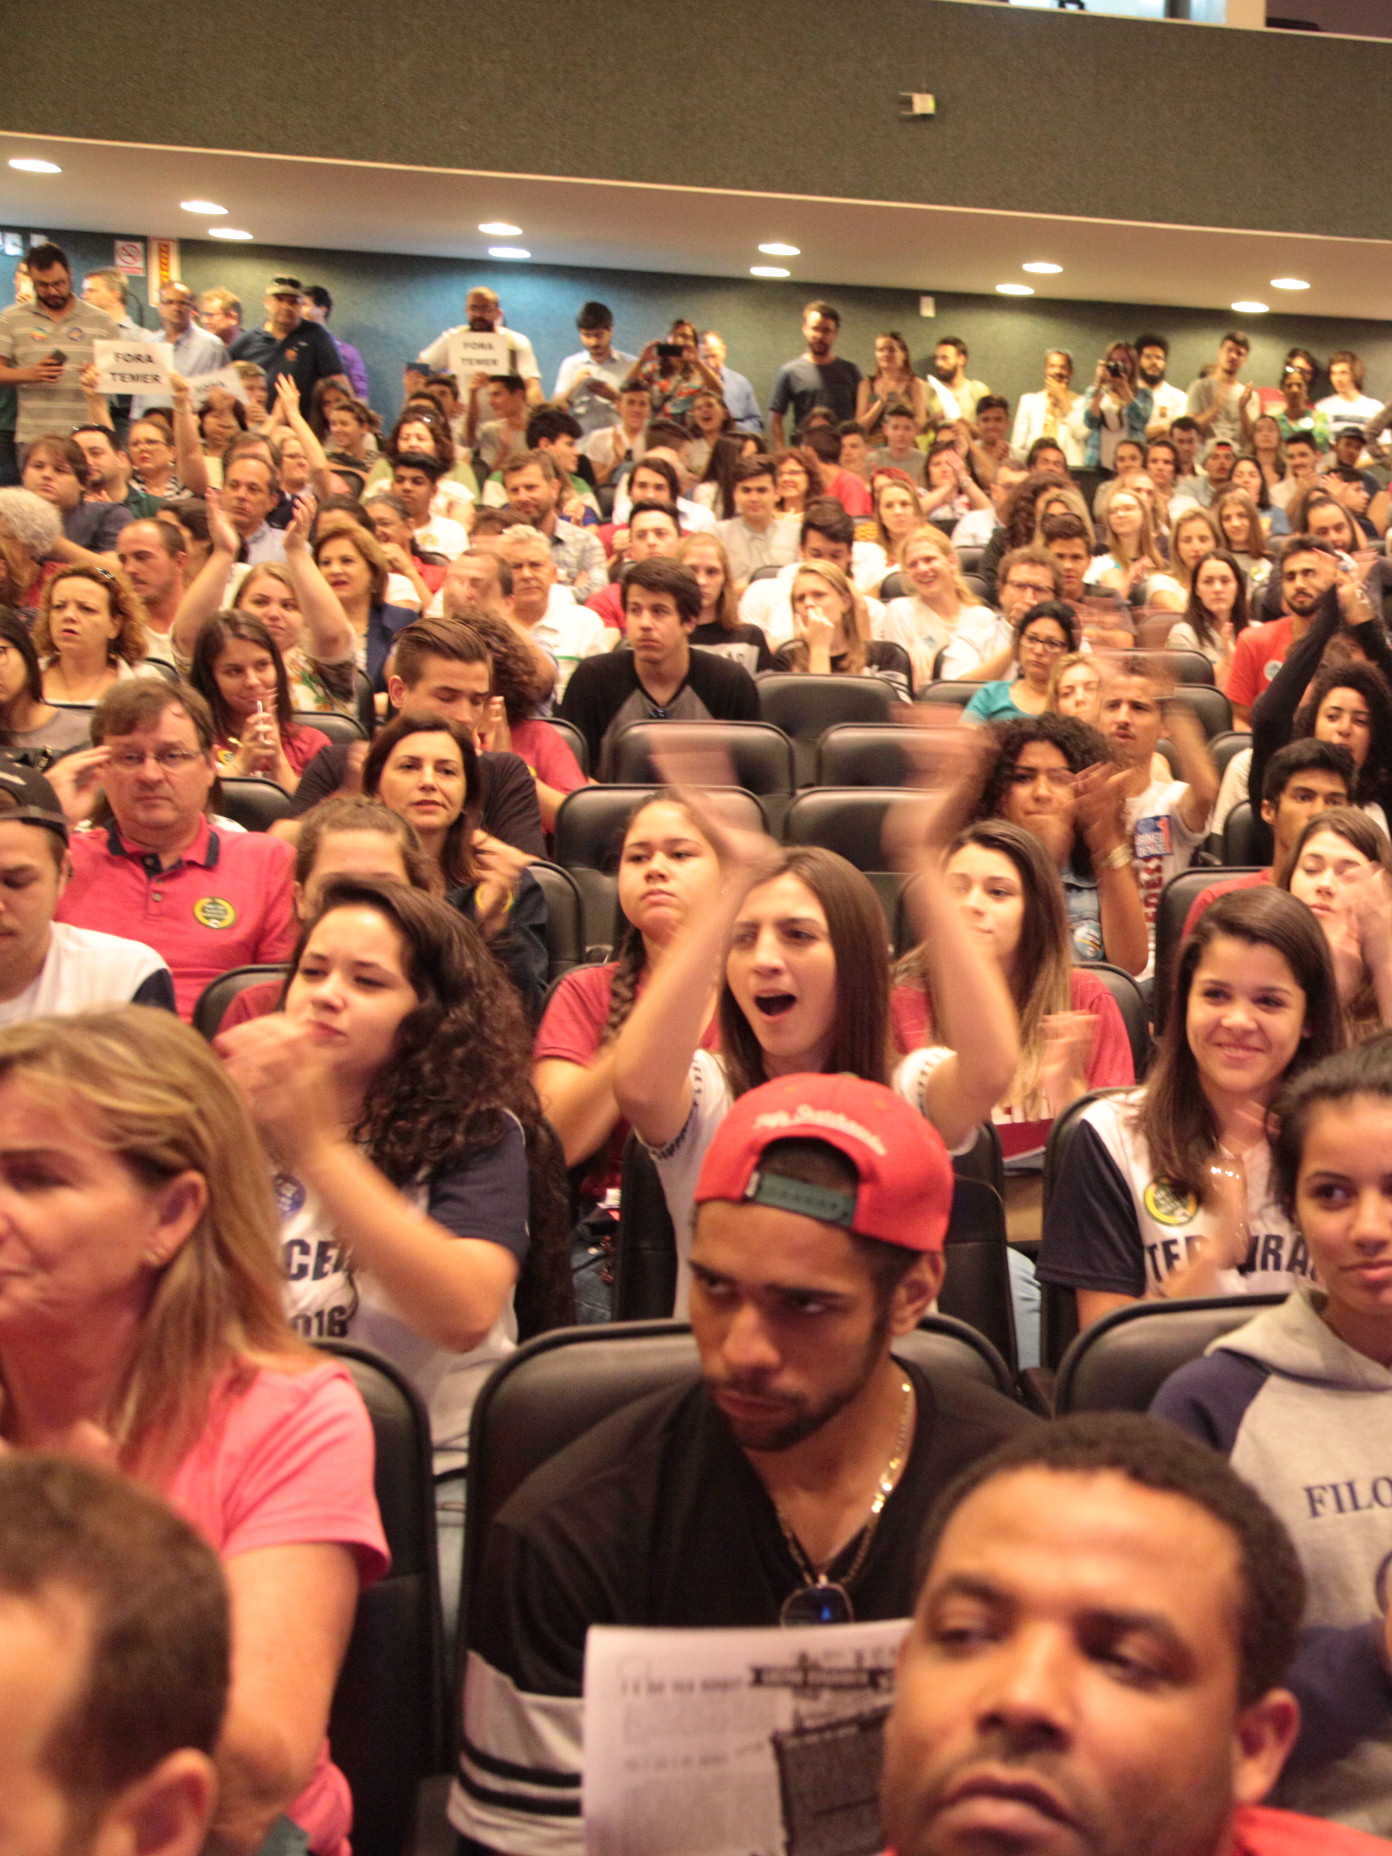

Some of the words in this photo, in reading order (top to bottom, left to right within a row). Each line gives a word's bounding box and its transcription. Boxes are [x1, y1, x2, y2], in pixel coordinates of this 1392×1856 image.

[113, 352, 155, 364] FORA
[109, 371, 162, 384] TEMER
[291, 1305, 349, 1338] 016
